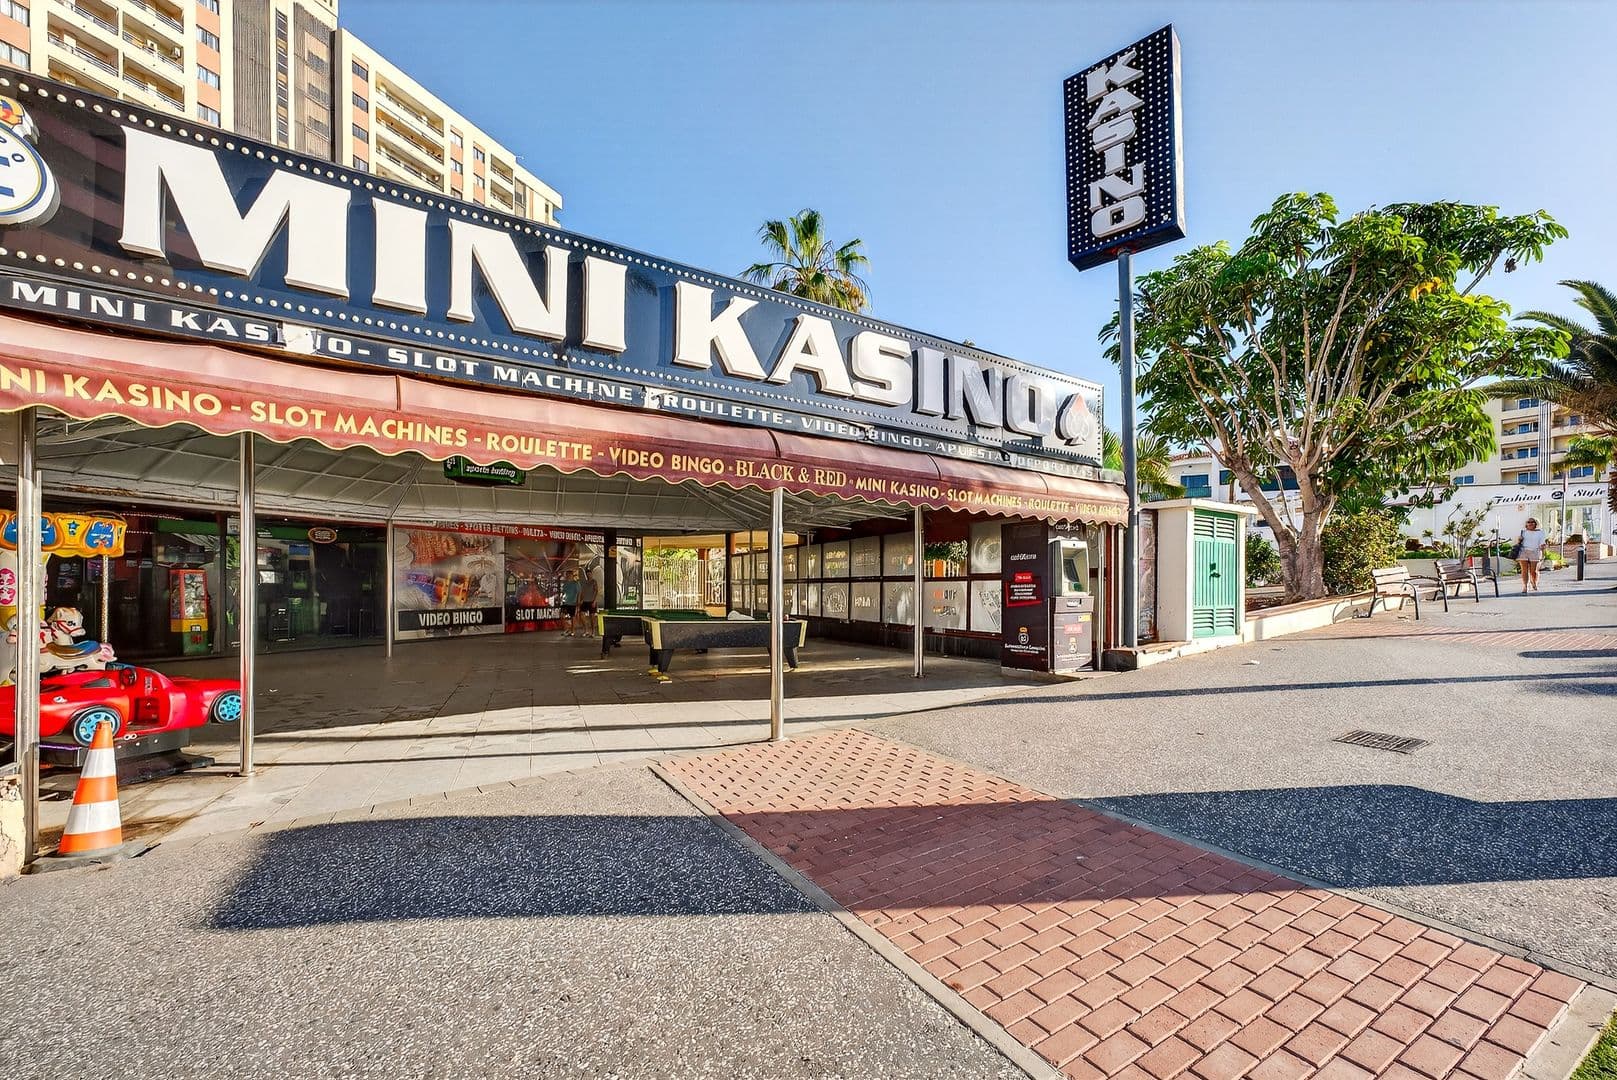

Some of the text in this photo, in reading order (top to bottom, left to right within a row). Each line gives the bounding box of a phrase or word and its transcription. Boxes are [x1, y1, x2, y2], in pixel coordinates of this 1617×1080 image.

[1085, 48, 1146, 239] KASINO
[11, 281, 146, 322] MINI
[388, 349, 479, 375] SLOT
[493, 365, 632, 400] MACHINE
[117, 125, 1051, 437] MINI KASINO
[63, 373, 222, 416] KASINO
[250, 400, 326, 430] SLOT
[333, 413, 468, 448] MACHINES
[486, 432, 593, 461] ROULETTE
[609, 447, 664, 468] VIDEO
[671, 454, 725, 474] BINGO
[735, 460, 799, 483] BLACK
[799, 466, 810, 484] &
[815, 470, 846, 488] RED
[855, 476, 886, 494] MINI
[947, 488, 973, 502] SLOT
[974, 491, 1022, 509] MACHINES
[1492, 487, 1607, 505] Fashion Style
[418, 610, 483, 626] VIDEO BINGO
[515, 608, 535, 621] SLOT
